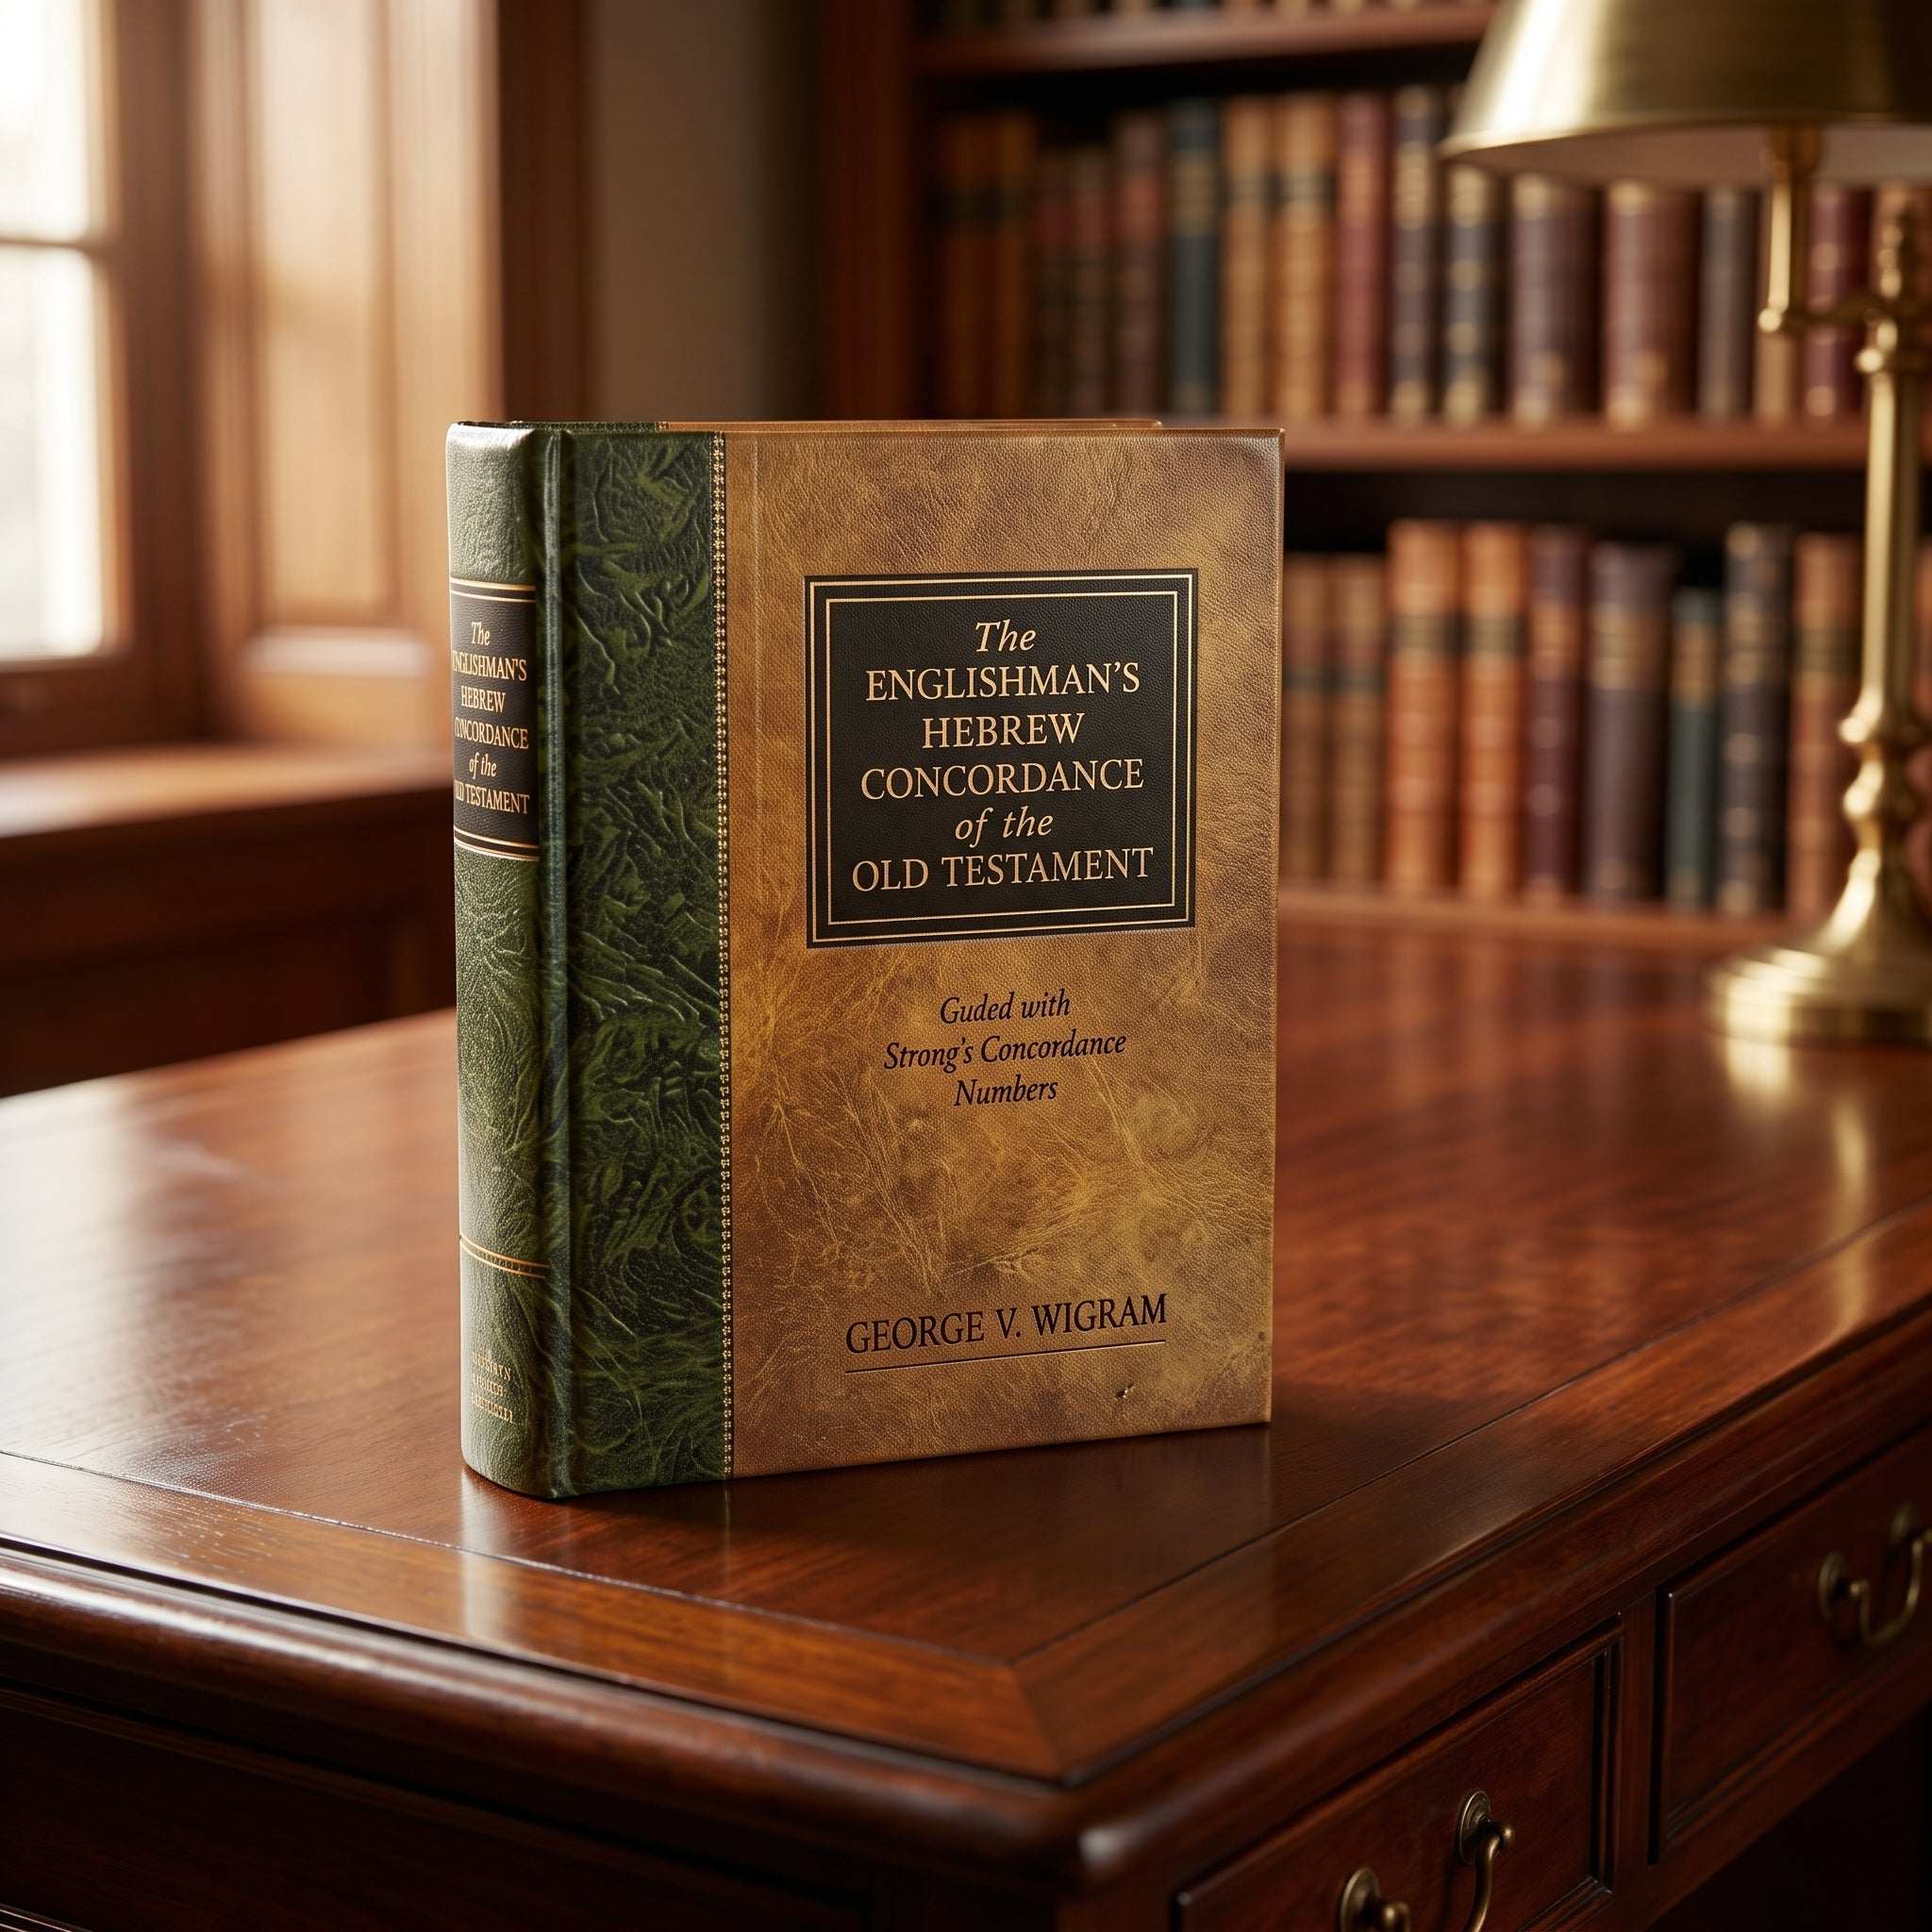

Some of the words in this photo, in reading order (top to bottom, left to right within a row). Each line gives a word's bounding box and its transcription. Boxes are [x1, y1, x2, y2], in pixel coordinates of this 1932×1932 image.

[471, 621, 491, 646] The
[974, 619, 1036, 653] The
[460, 685, 507, 713] HEBREW
[866, 662, 1141, 701] ENGLISHMAN’S
[921, 711, 1086, 749] HEBREW
[469, 752, 480, 779] of
[480, 754, 497, 777] the
[860, 758, 1144, 800] CONCORDANCE
[465, 784, 529, 814] TESTAMENT
[954, 808, 993, 848] of
[1003, 806, 1054, 839] the
[852, 858, 929, 892] OLD
[941, 847, 1155, 888] TESTAMENT
[940, 991, 1015, 1025] Guded
[1021, 988, 1071, 1019] with
[883, 1037, 974, 1074] Strong’s
[980, 1029, 1126, 1064] Concordance
[954, 1074, 1058, 1108] Numbers
[845, 1310, 985, 1355] GEORGE
[995, 1307, 1023, 1340] V.
[1031, 1292, 1168, 1337] WIGRAM
